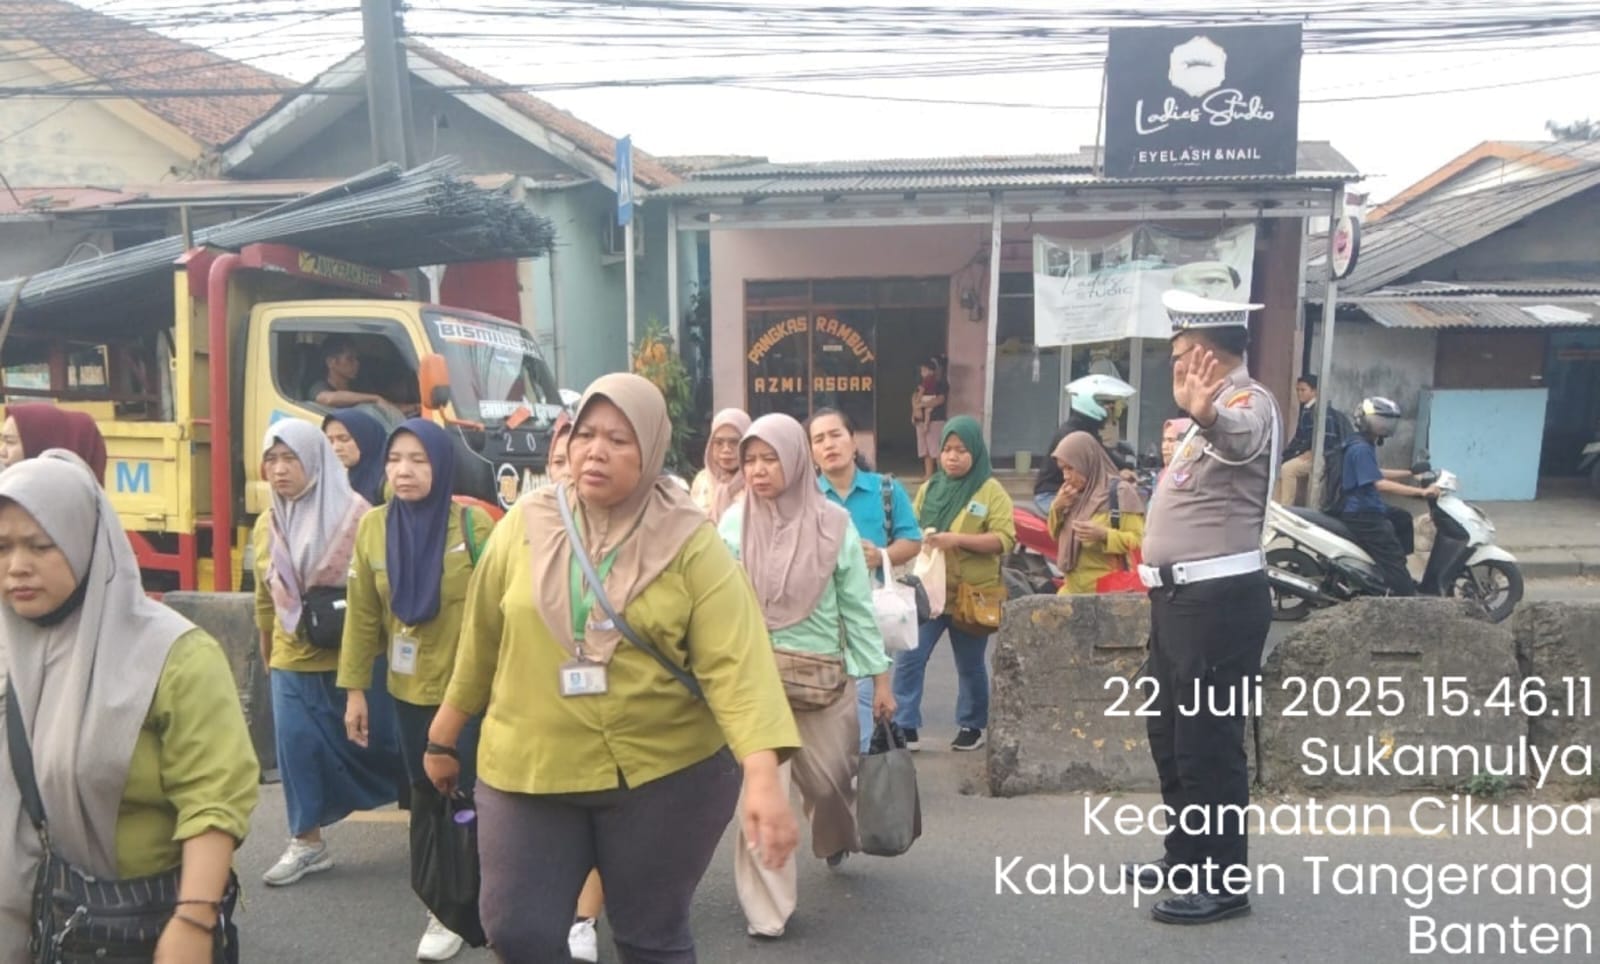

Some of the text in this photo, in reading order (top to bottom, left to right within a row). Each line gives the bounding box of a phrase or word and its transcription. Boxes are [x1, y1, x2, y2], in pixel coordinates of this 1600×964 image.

[1135, 88, 1275, 135] Ladies Studio
[1138, 148, 1210, 163] EYELASH
[748, 316, 875, 366] PANGKAS RAMBUT
[754, 376, 873, 394] AZMI ASGAR
